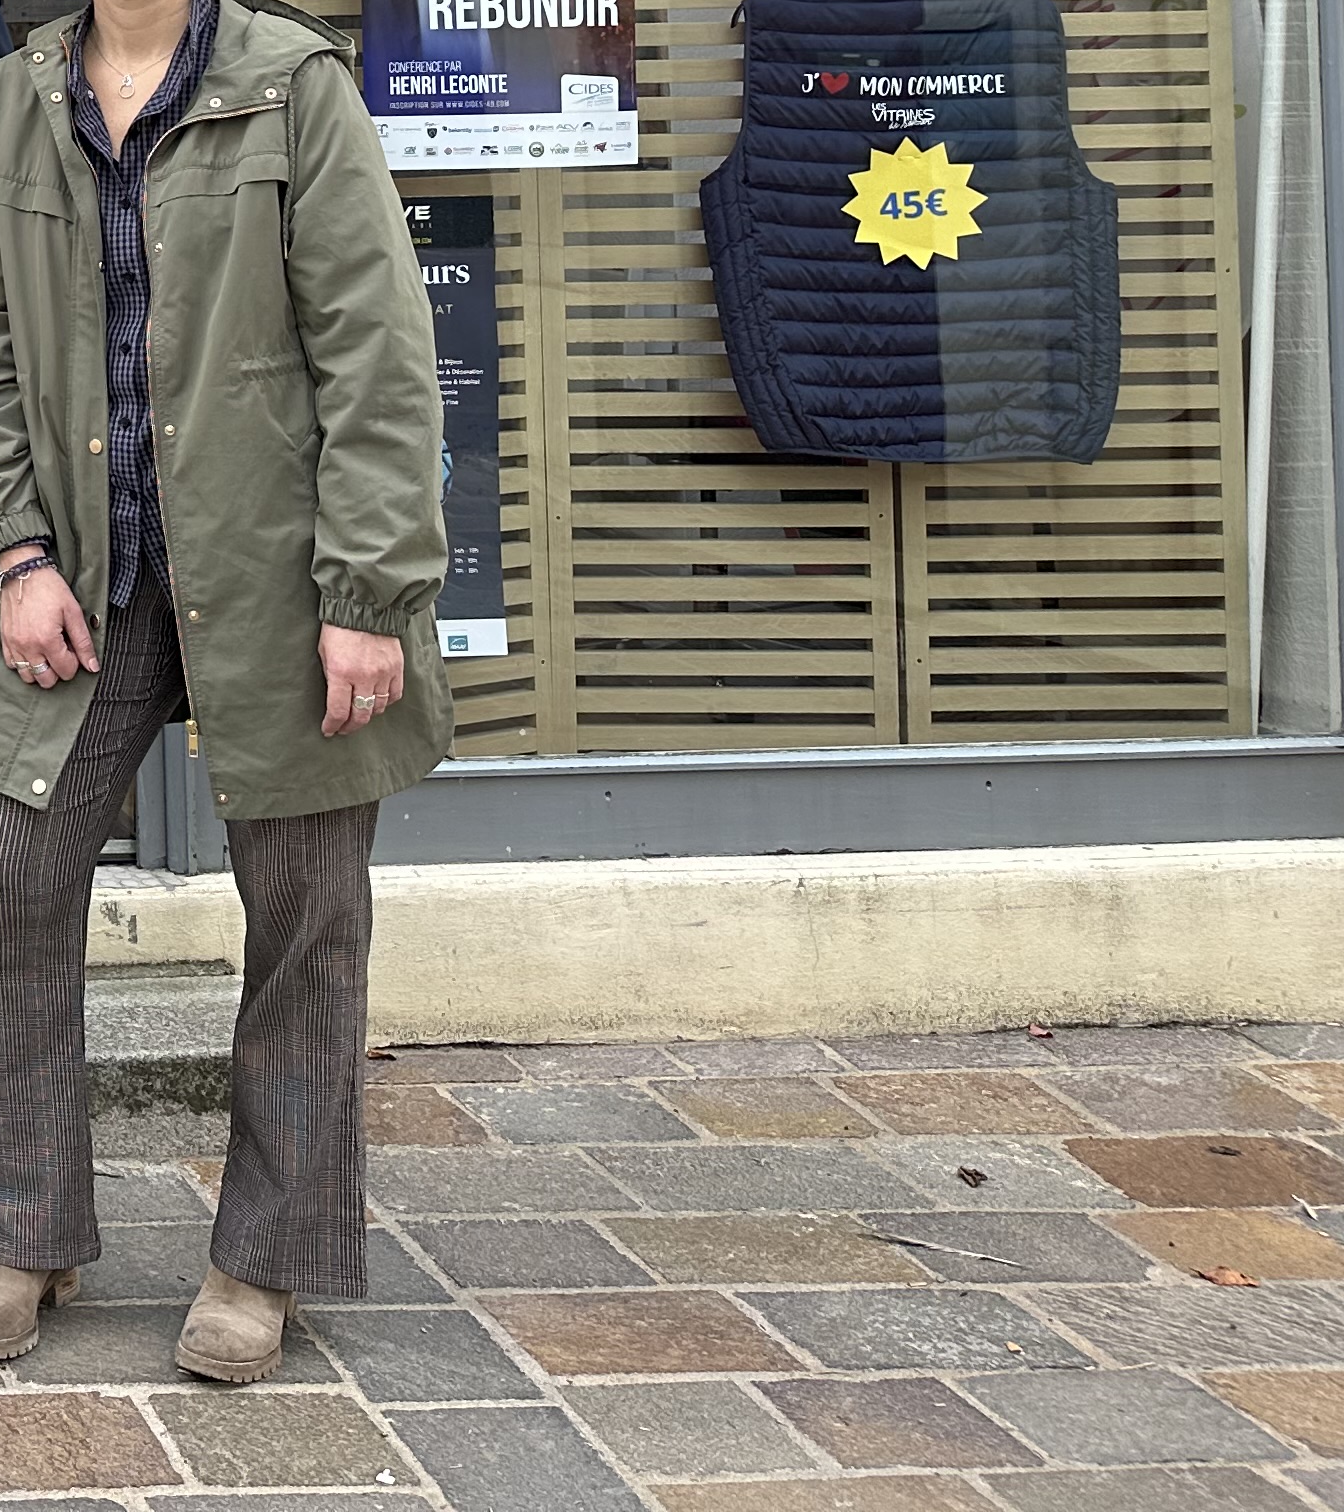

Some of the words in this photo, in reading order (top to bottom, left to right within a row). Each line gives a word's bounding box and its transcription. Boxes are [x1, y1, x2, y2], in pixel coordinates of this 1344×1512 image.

[389, 60, 443, 73] CONFÉRENCE
[444, 61, 462, 72] PAR
[389, 76, 437, 95] HENRI
[440, 74, 508, 94] LECONTE
[568, 83, 614, 95] CIDES
[860, 76, 902, 96] MON
[907, 73, 1006, 96] COMMERCE
[871, 108, 936, 122] VITRINES
[879, 188, 948, 220] 45€
